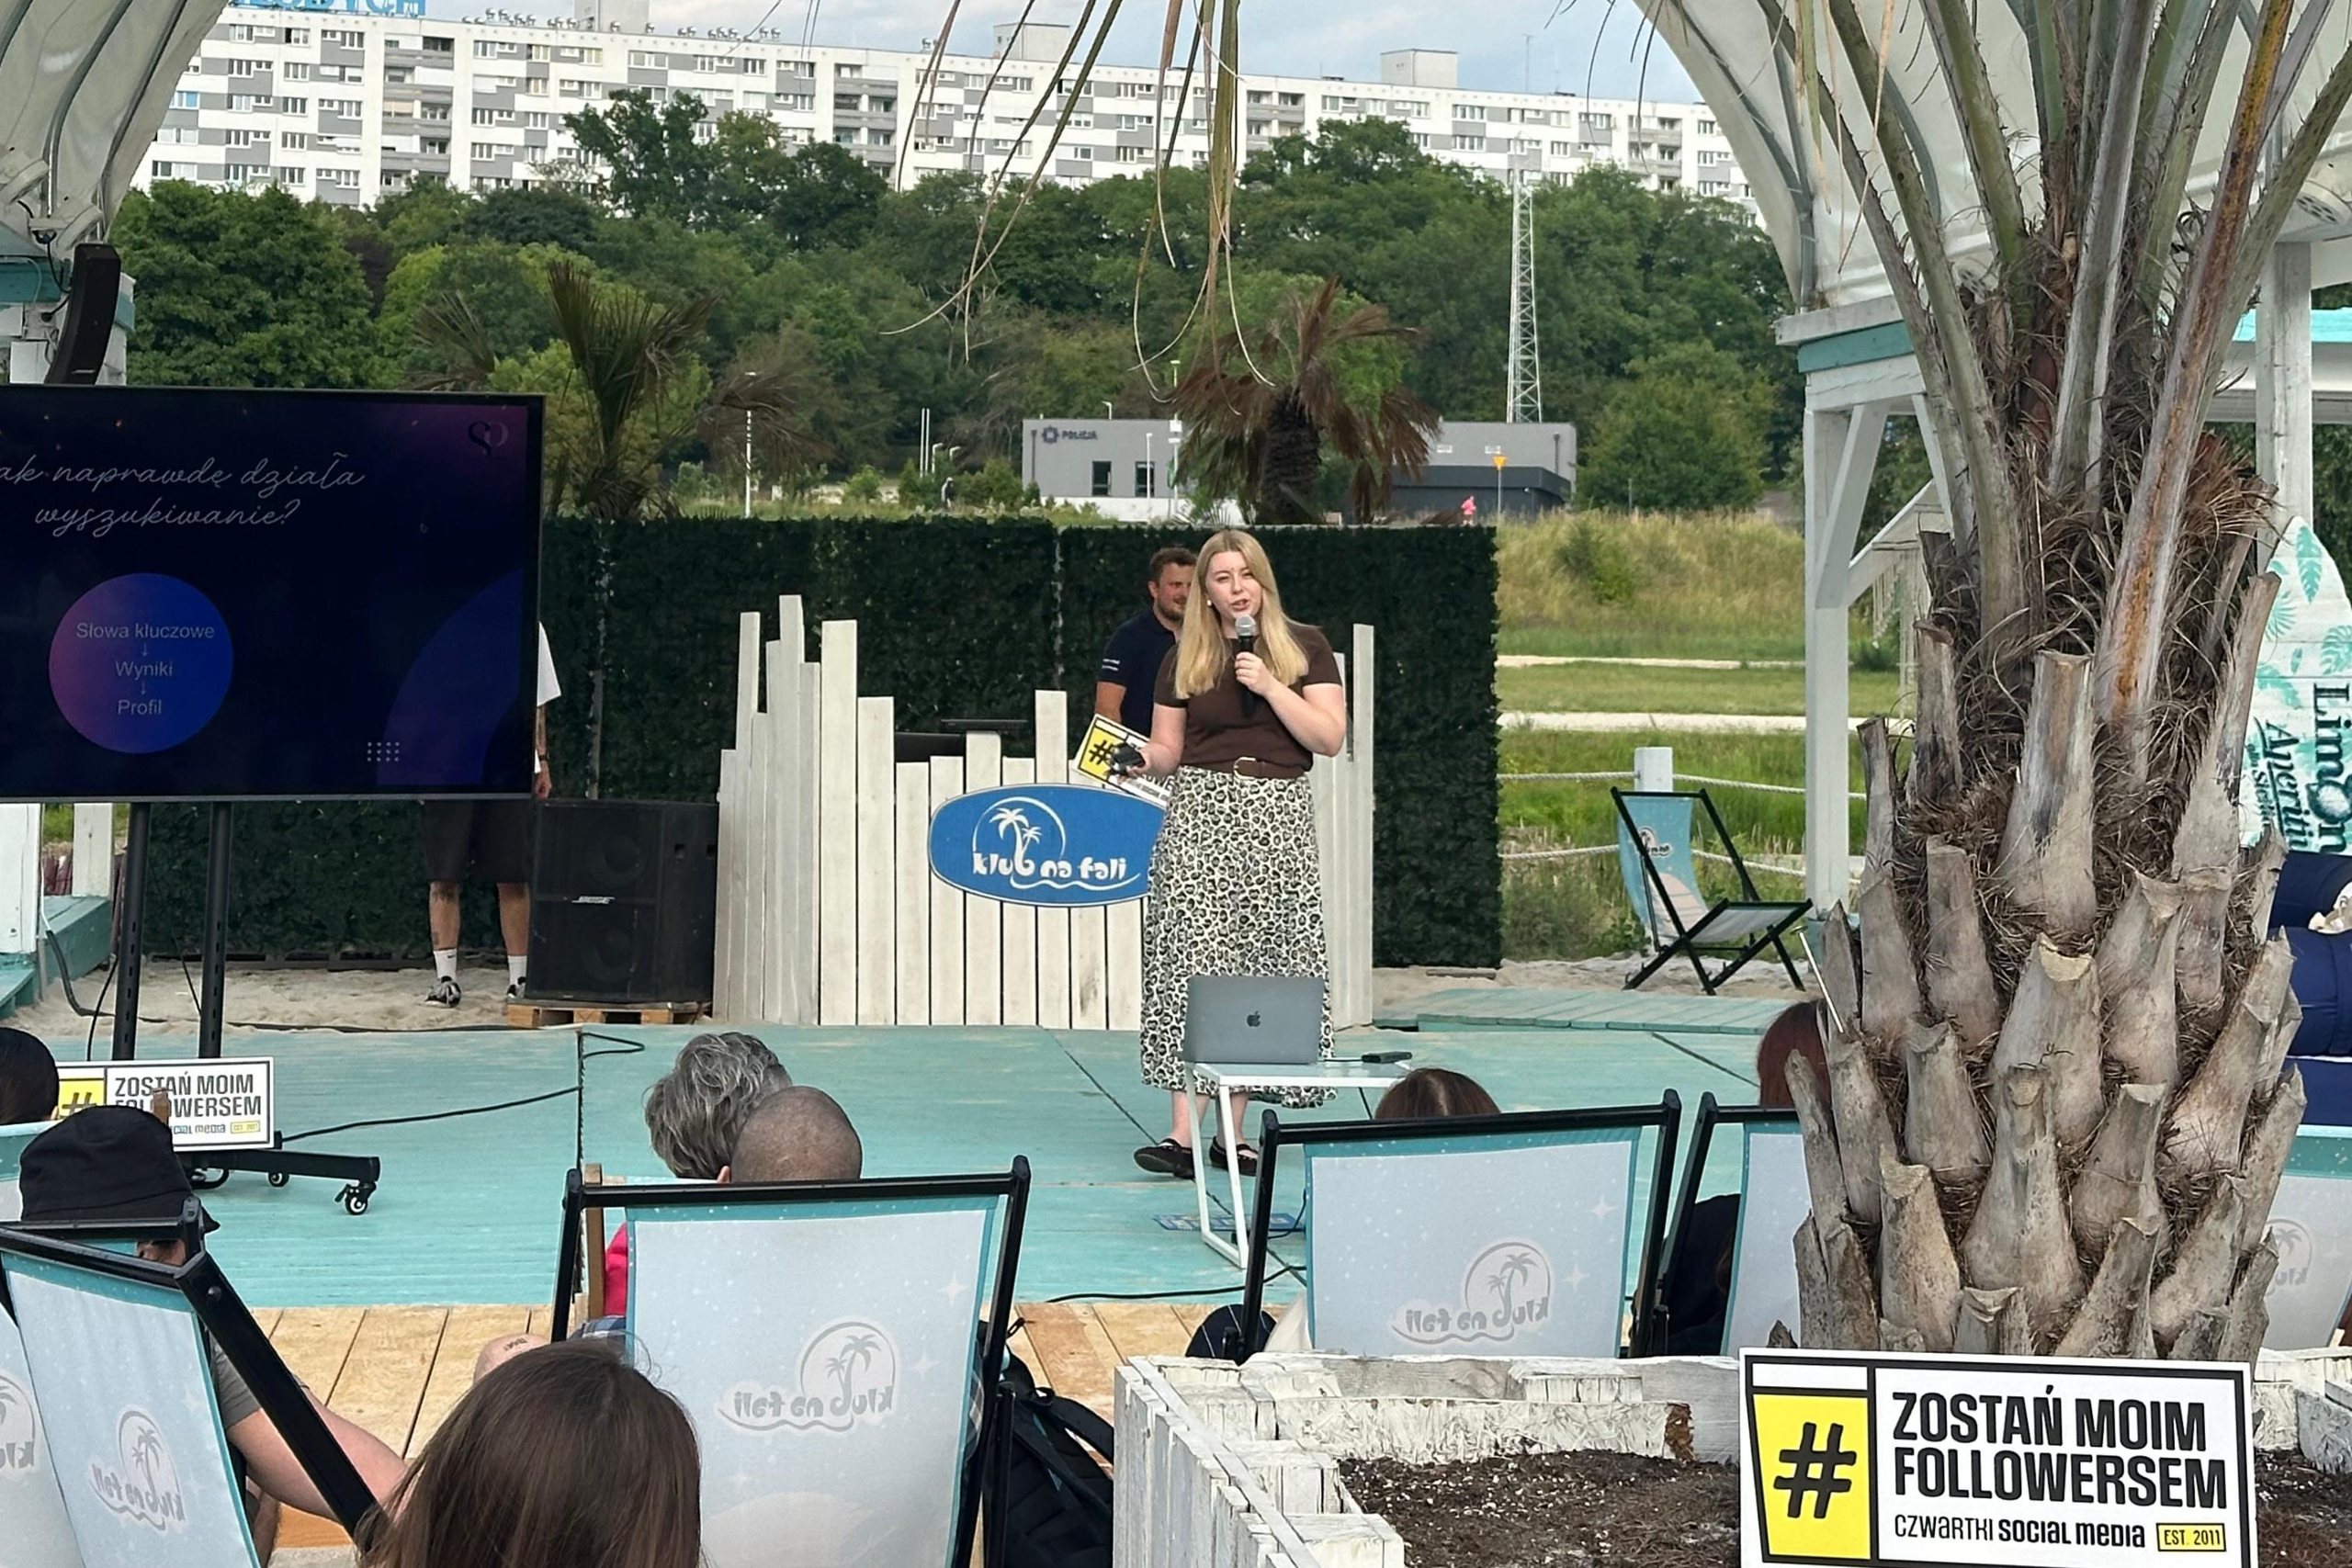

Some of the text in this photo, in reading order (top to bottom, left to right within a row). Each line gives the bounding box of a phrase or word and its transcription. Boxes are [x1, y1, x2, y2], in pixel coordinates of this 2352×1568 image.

[0, 455, 44, 485] ak
[51, 457, 232, 492] naprawdę
[34, 497, 301, 538] wyszukiwanie?
[75, 622, 215, 638] Słowa kluczowe
[115, 660, 173, 681] Wyniki
[118, 699, 163, 716] Profil
[972, 851, 1126, 880] klub na fali
[115, 1071, 254, 1097] ZOSTAŃ MOIM
[116, 1096, 261, 1118] LWERSEM
[1892, 1384, 2206, 1451] ZOSTAŃ MOIM
[1894, 1447, 2227, 1509] FOLLOWERSEM
[2192, 1529, 2221, 1546] 2011
